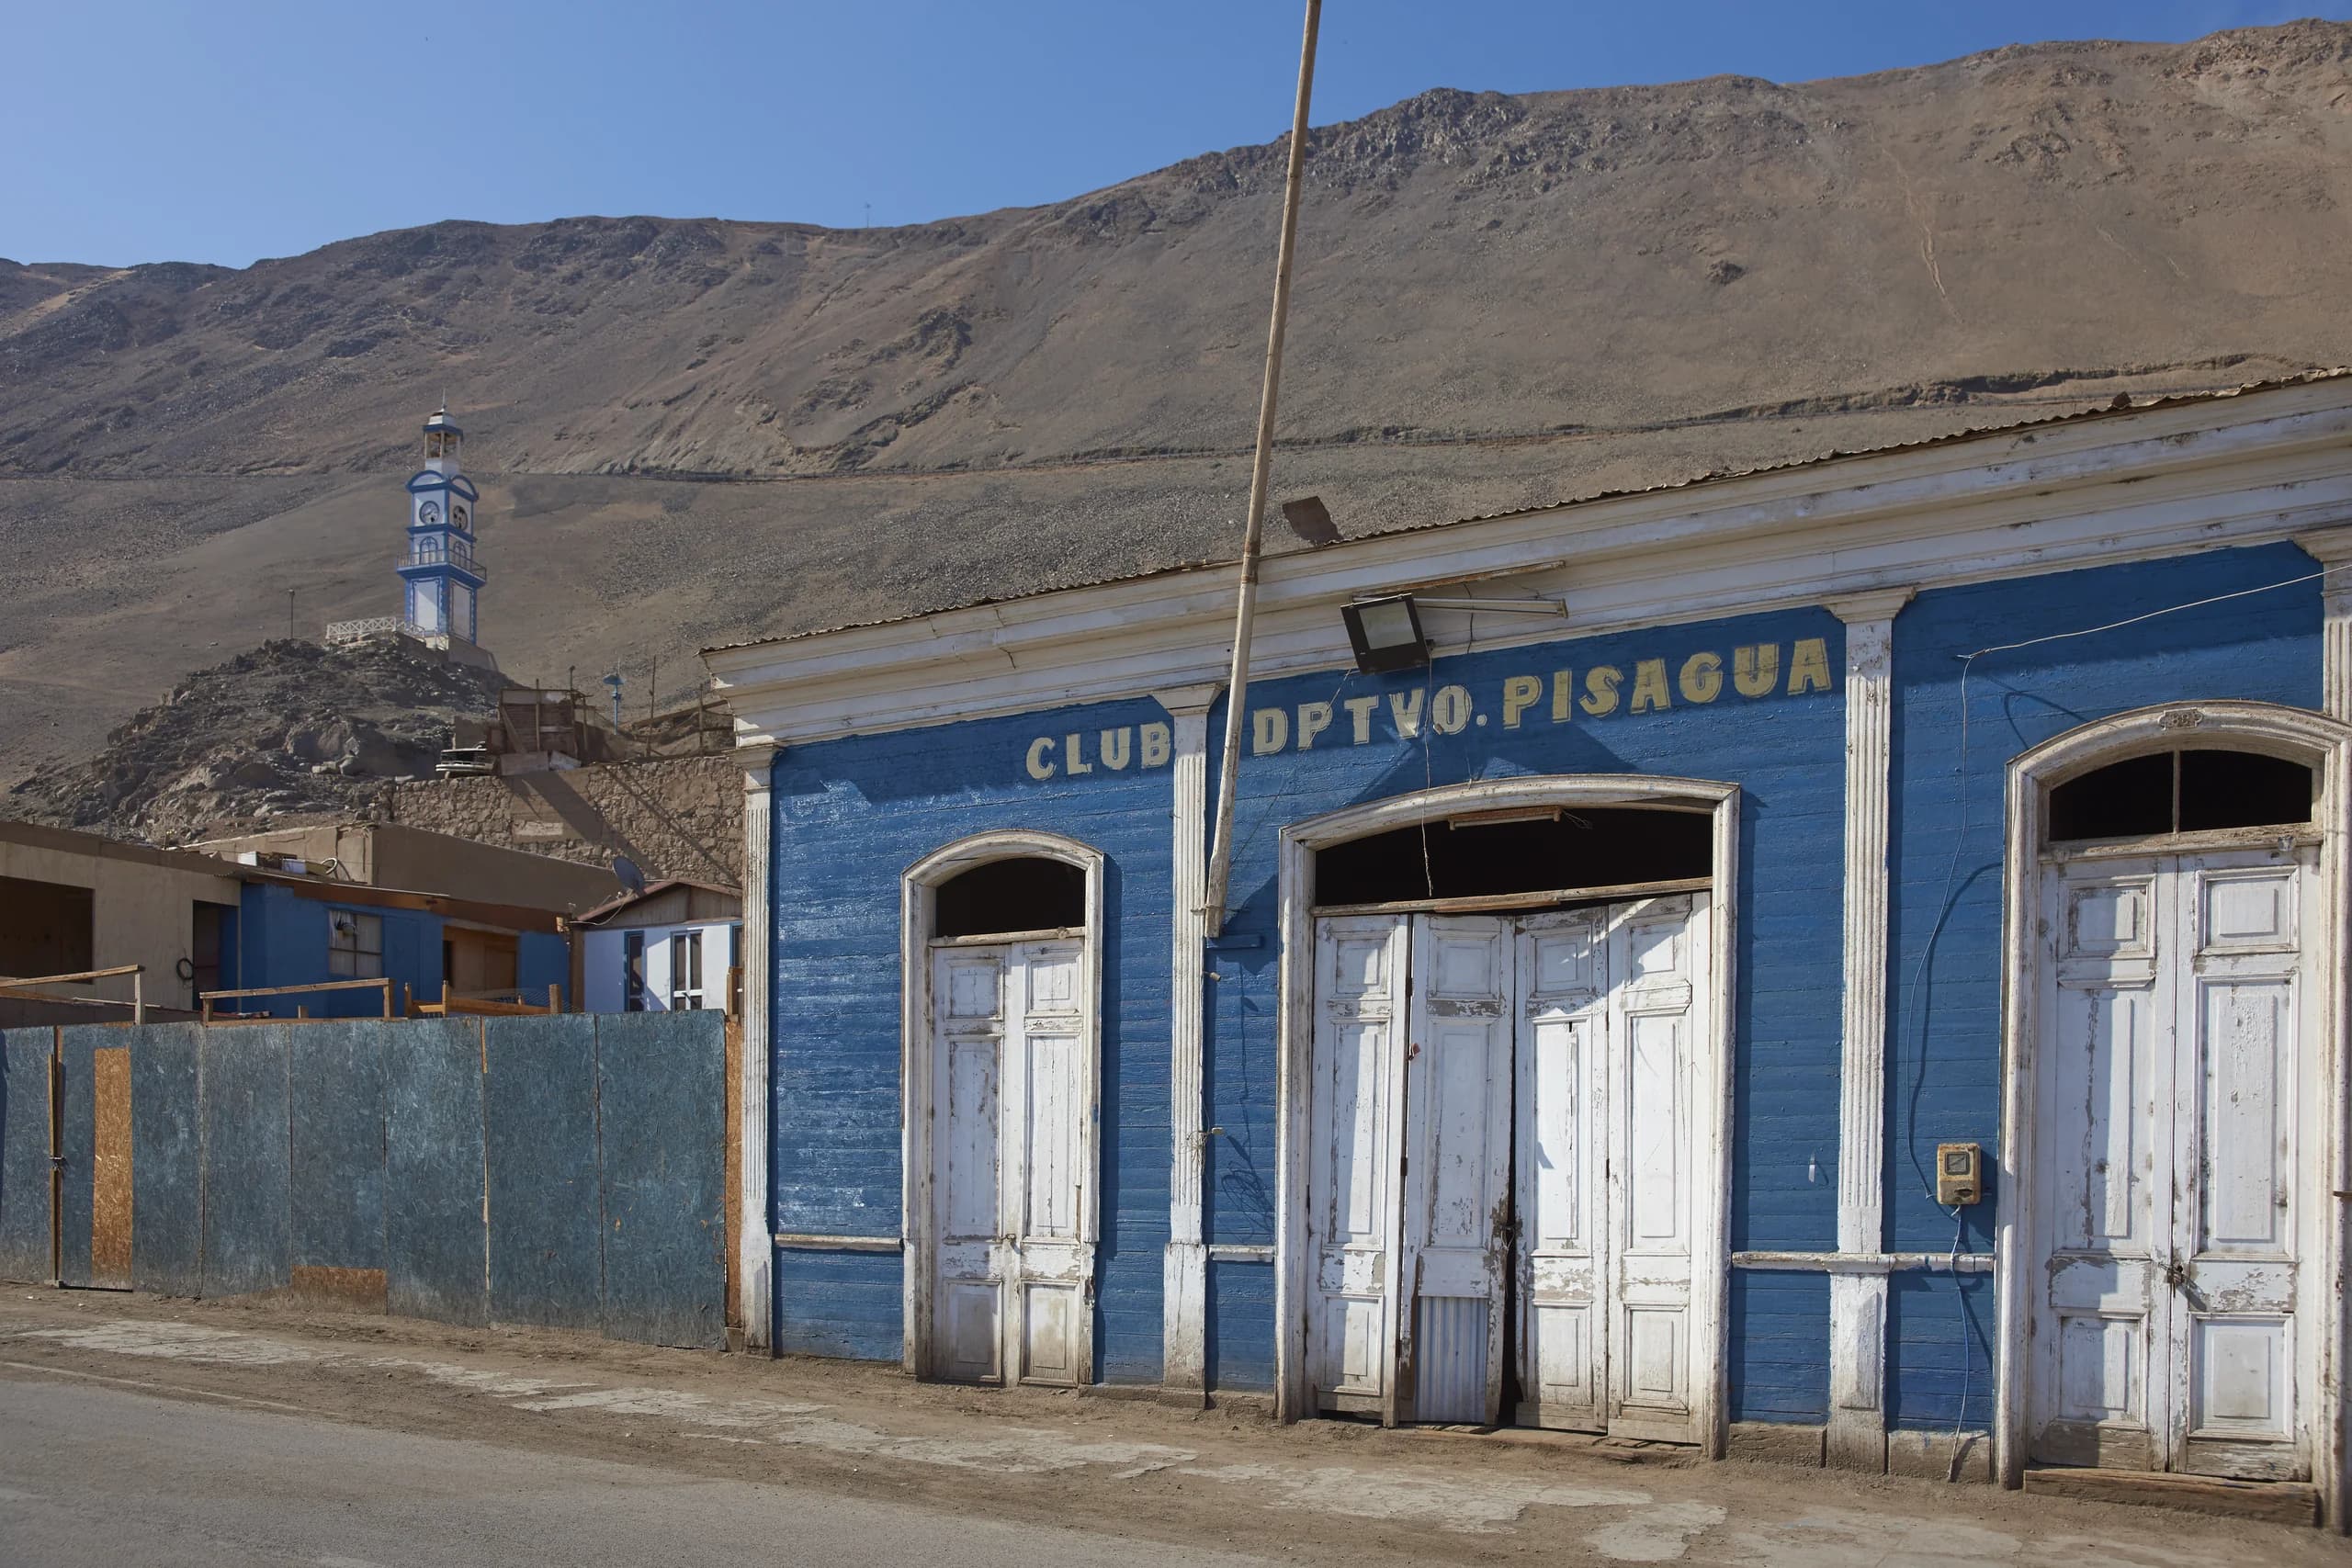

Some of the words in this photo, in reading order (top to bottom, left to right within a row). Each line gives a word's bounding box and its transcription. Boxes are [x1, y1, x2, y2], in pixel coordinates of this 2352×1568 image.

[1026, 720, 1171, 781] CLUB
[1253, 684, 1487, 756] DPTVO.
[1503, 637, 1832, 729] PISAGUA
